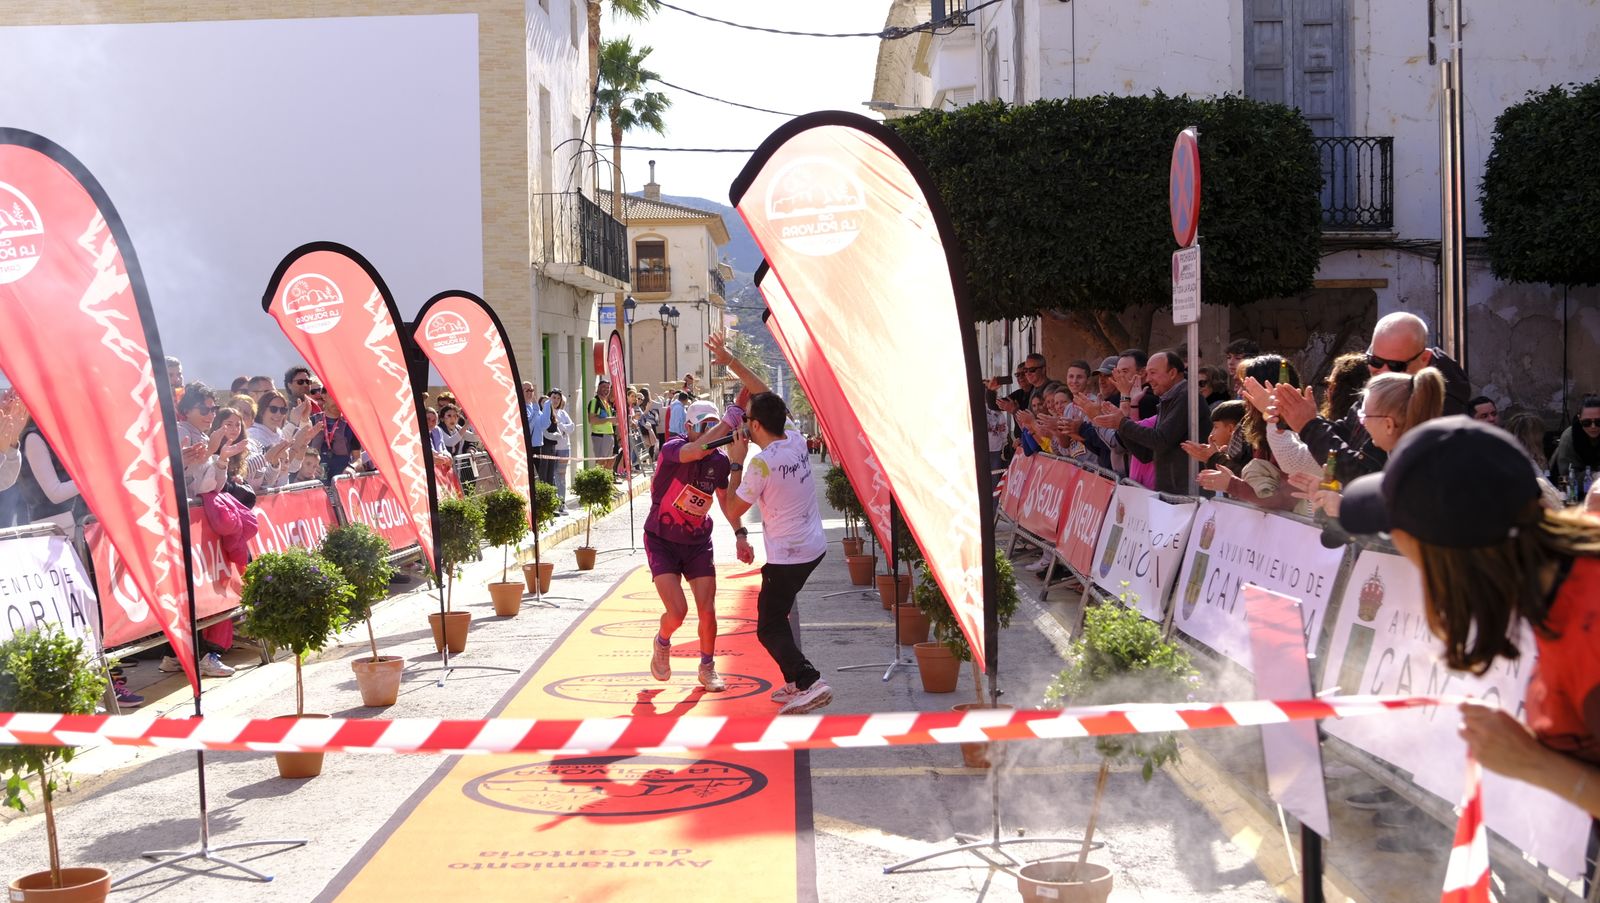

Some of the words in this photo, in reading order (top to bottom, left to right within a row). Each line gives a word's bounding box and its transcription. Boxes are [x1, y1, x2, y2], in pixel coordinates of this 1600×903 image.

[689, 494, 706, 508] 38
[49, 567, 74, 587] DE
[1306, 572, 1325, 598] DE
[687, 766, 730, 775] LA
[478, 848, 638, 859] Cantoria
[648, 847, 693, 858] de
[447, 858, 713, 871] Ayuntamiento
